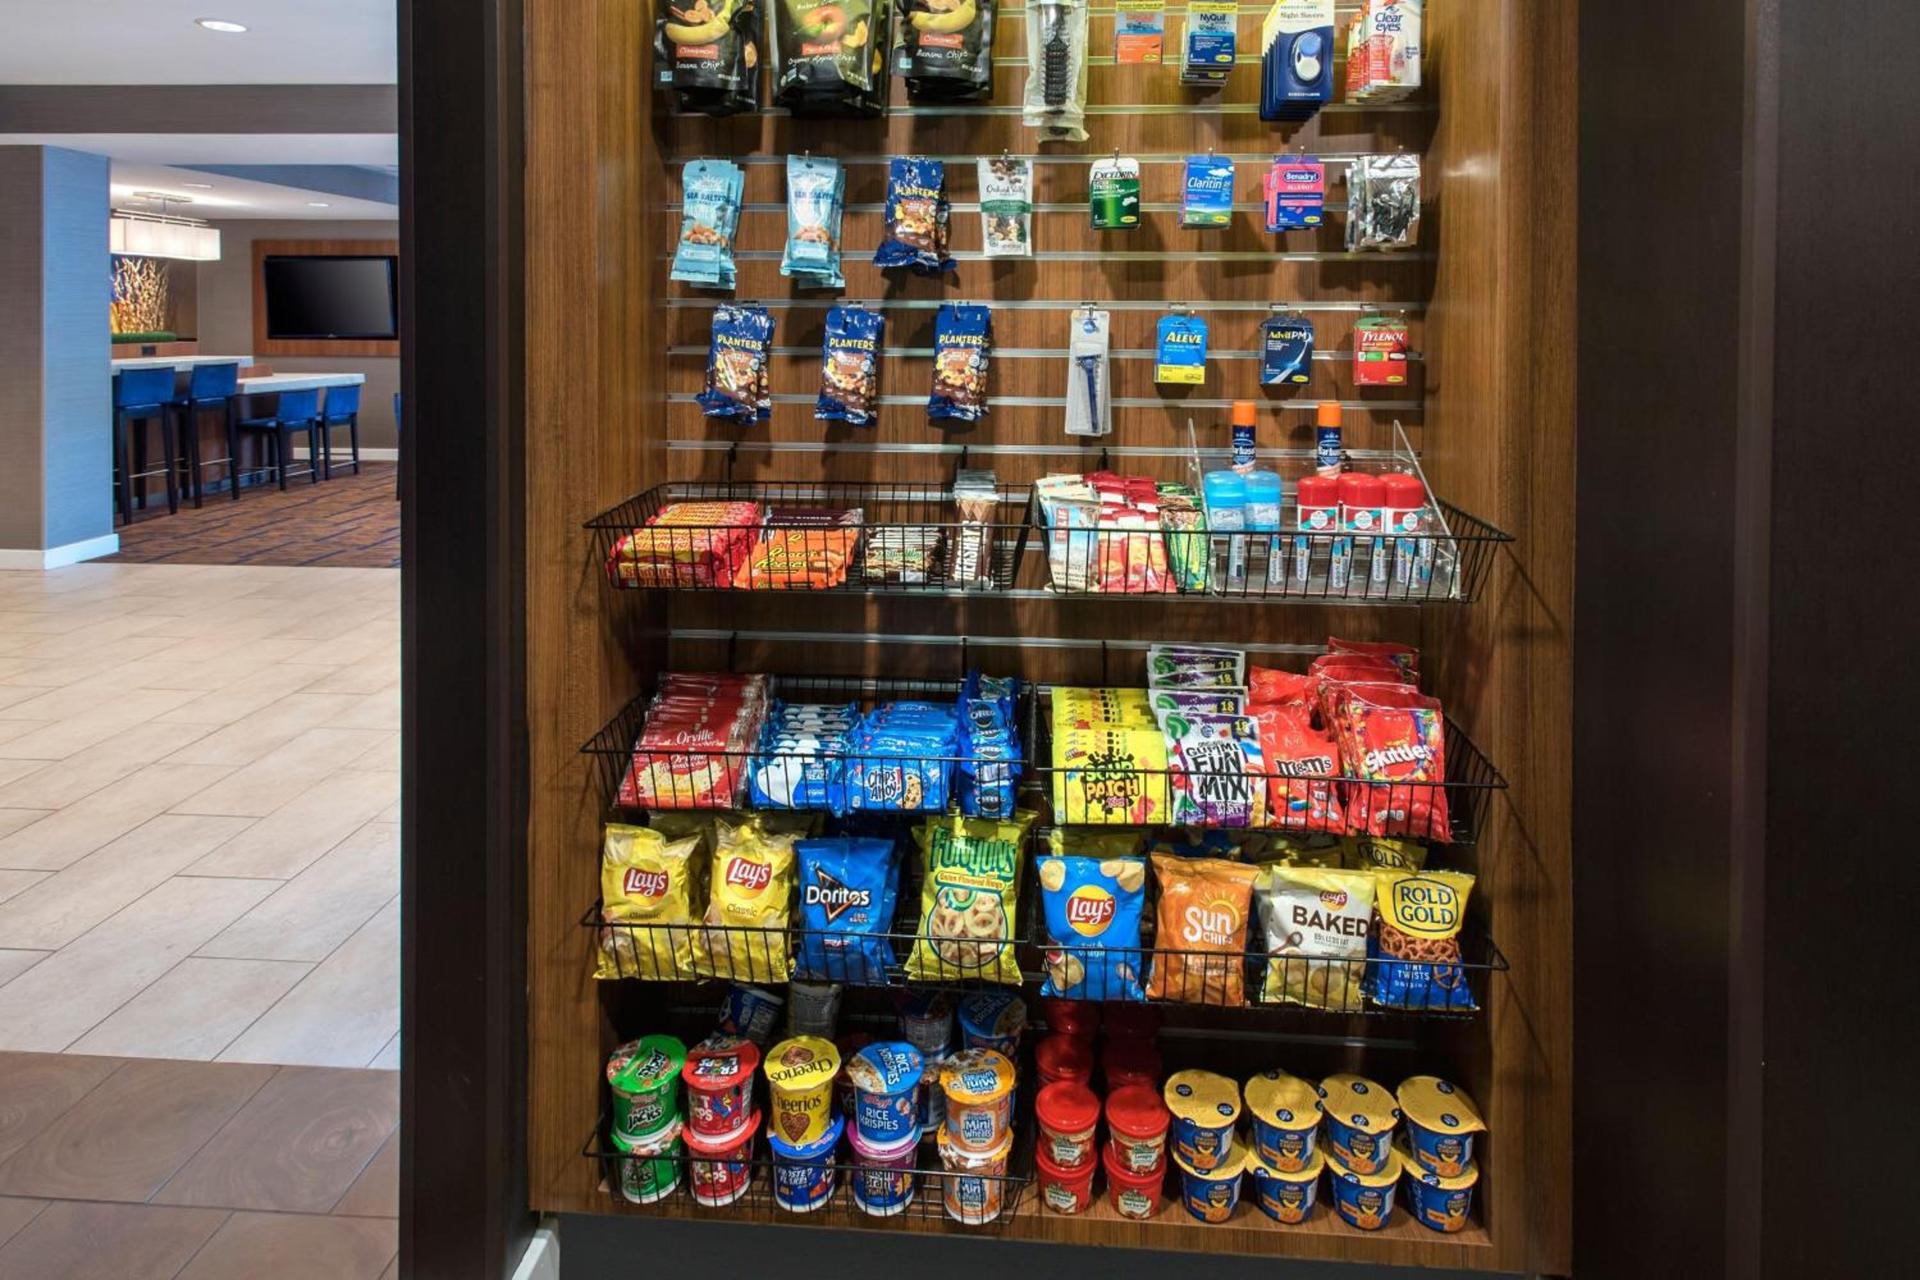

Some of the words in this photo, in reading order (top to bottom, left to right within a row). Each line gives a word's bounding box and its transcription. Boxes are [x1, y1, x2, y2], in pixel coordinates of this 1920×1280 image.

[1374, 11, 1403, 23] Clear
[1375, 22, 1402, 33] eyes
[944, 50, 969, 60] Chips
[700, 60, 725, 70] Chips
[1187, 176, 1223, 190] Claritin
[938, 334, 984, 345] PLANTERS
[1165, 331, 1203, 345] ALEVE
[1267, 330, 1291, 340] Advil
[1362, 331, 1405, 343] TYLENOL
[717, 335, 763, 351] PLANTERS
[829, 337, 875, 350] PLANTERS
[1219, 661, 1233, 670] 18
[1219, 673, 1232, 683] 18
[1220, 700, 1235, 711] 18
[1235, 719, 1249, 731] 18
[676, 728, 715, 746] Orville
[1192, 751, 1241, 773] FUN
[1366, 745, 1432, 774] Skittles
[1086, 778, 1140, 802] PATCH
[729, 857, 771, 888] Lay's
[626, 868, 668, 897] Lay's
[806, 885, 870, 906] Doritos
[1320, 890, 1347, 904] Lay's
[1401, 886, 1452, 906] ROLD
[727, 904, 759, 917] Classic
[1070, 898, 1113, 924] Lay's
[1401, 905, 1454, 925] GOLD
[1184, 905, 1232, 942] Sun
[1292, 905, 1369, 938] BAKED
[1203, 931, 1233, 945] CHIPS
[1397, 970, 1431, 981] TWISTS
[771, 1057, 833, 1084] Cheerios
[895, 1053, 911, 1075] RICE
[967, 1075, 995, 1089] Mini
[627, 1106, 663, 1132] JACKS
[865, 1107, 889, 1119] RICE
[859, 1114, 899, 1131] KRISPIES
[965, 1118, 991, 1130] Mini
